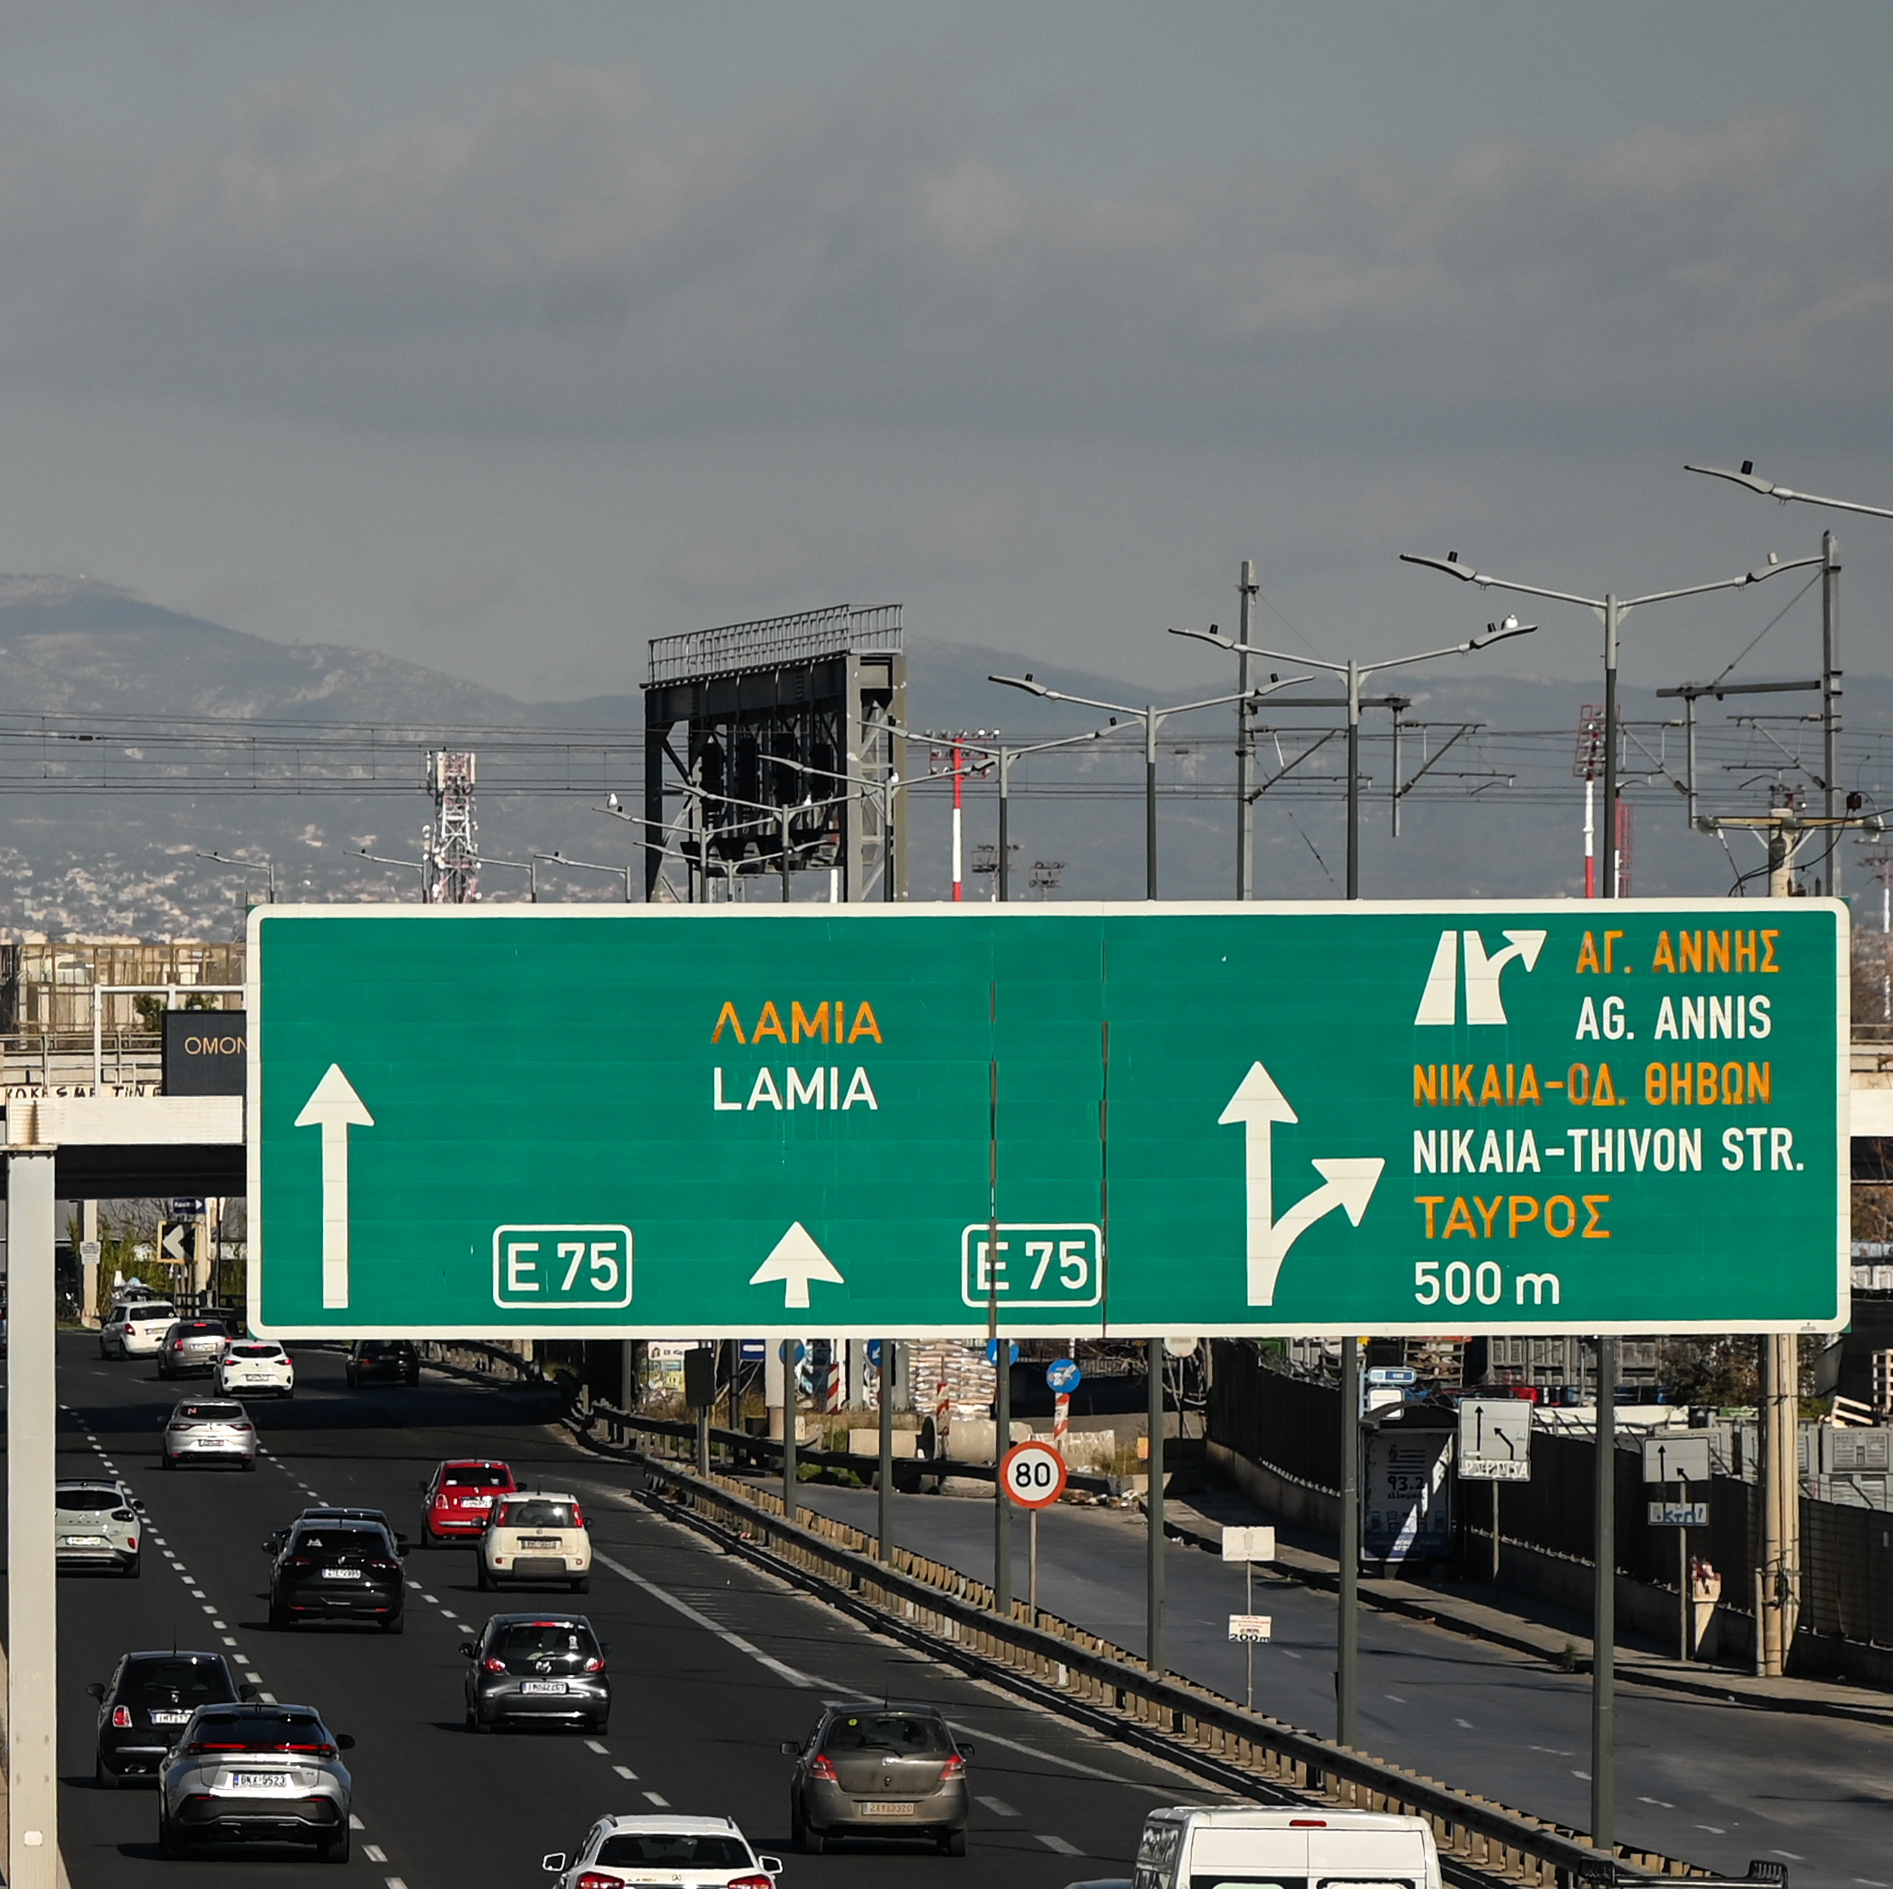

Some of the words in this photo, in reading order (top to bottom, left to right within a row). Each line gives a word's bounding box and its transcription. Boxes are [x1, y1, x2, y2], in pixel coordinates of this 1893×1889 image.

[1575, 929, 1632, 974] ΑΓ.
[1652, 929, 1780, 974] ΑΝΝΗΣ
[711, 1000, 884, 1045] ΛΑΜΙΑ
[1575, 995, 1635, 1040] AG.
[1654, 994, 1772, 1040] ANNIS
[713, 1066, 879, 1111] LAMIA
[1413, 1062, 1626, 1107] ΝΙΚΑΙΑ-ΟΔ.
[1644, 1061, 1771, 1106] ΘΗΒΩΝ
[1413, 1127, 1702, 1174] NIKAIA-THIVON
[1721, 1127, 1804, 1172] STR.
[1414, 1194, 1612, 1239] ΤΑΥΡΟΣ
[507, 1242, 540, 1292] E
[557, 1242, 619, 1292] 75
[1025, 1240, 1088, 1290] 75
[1414, 1260, 1502, 1306] 500
[1515, 1272, 1560, 1306] m
[1016, 1462, 1051, 1488] 80
